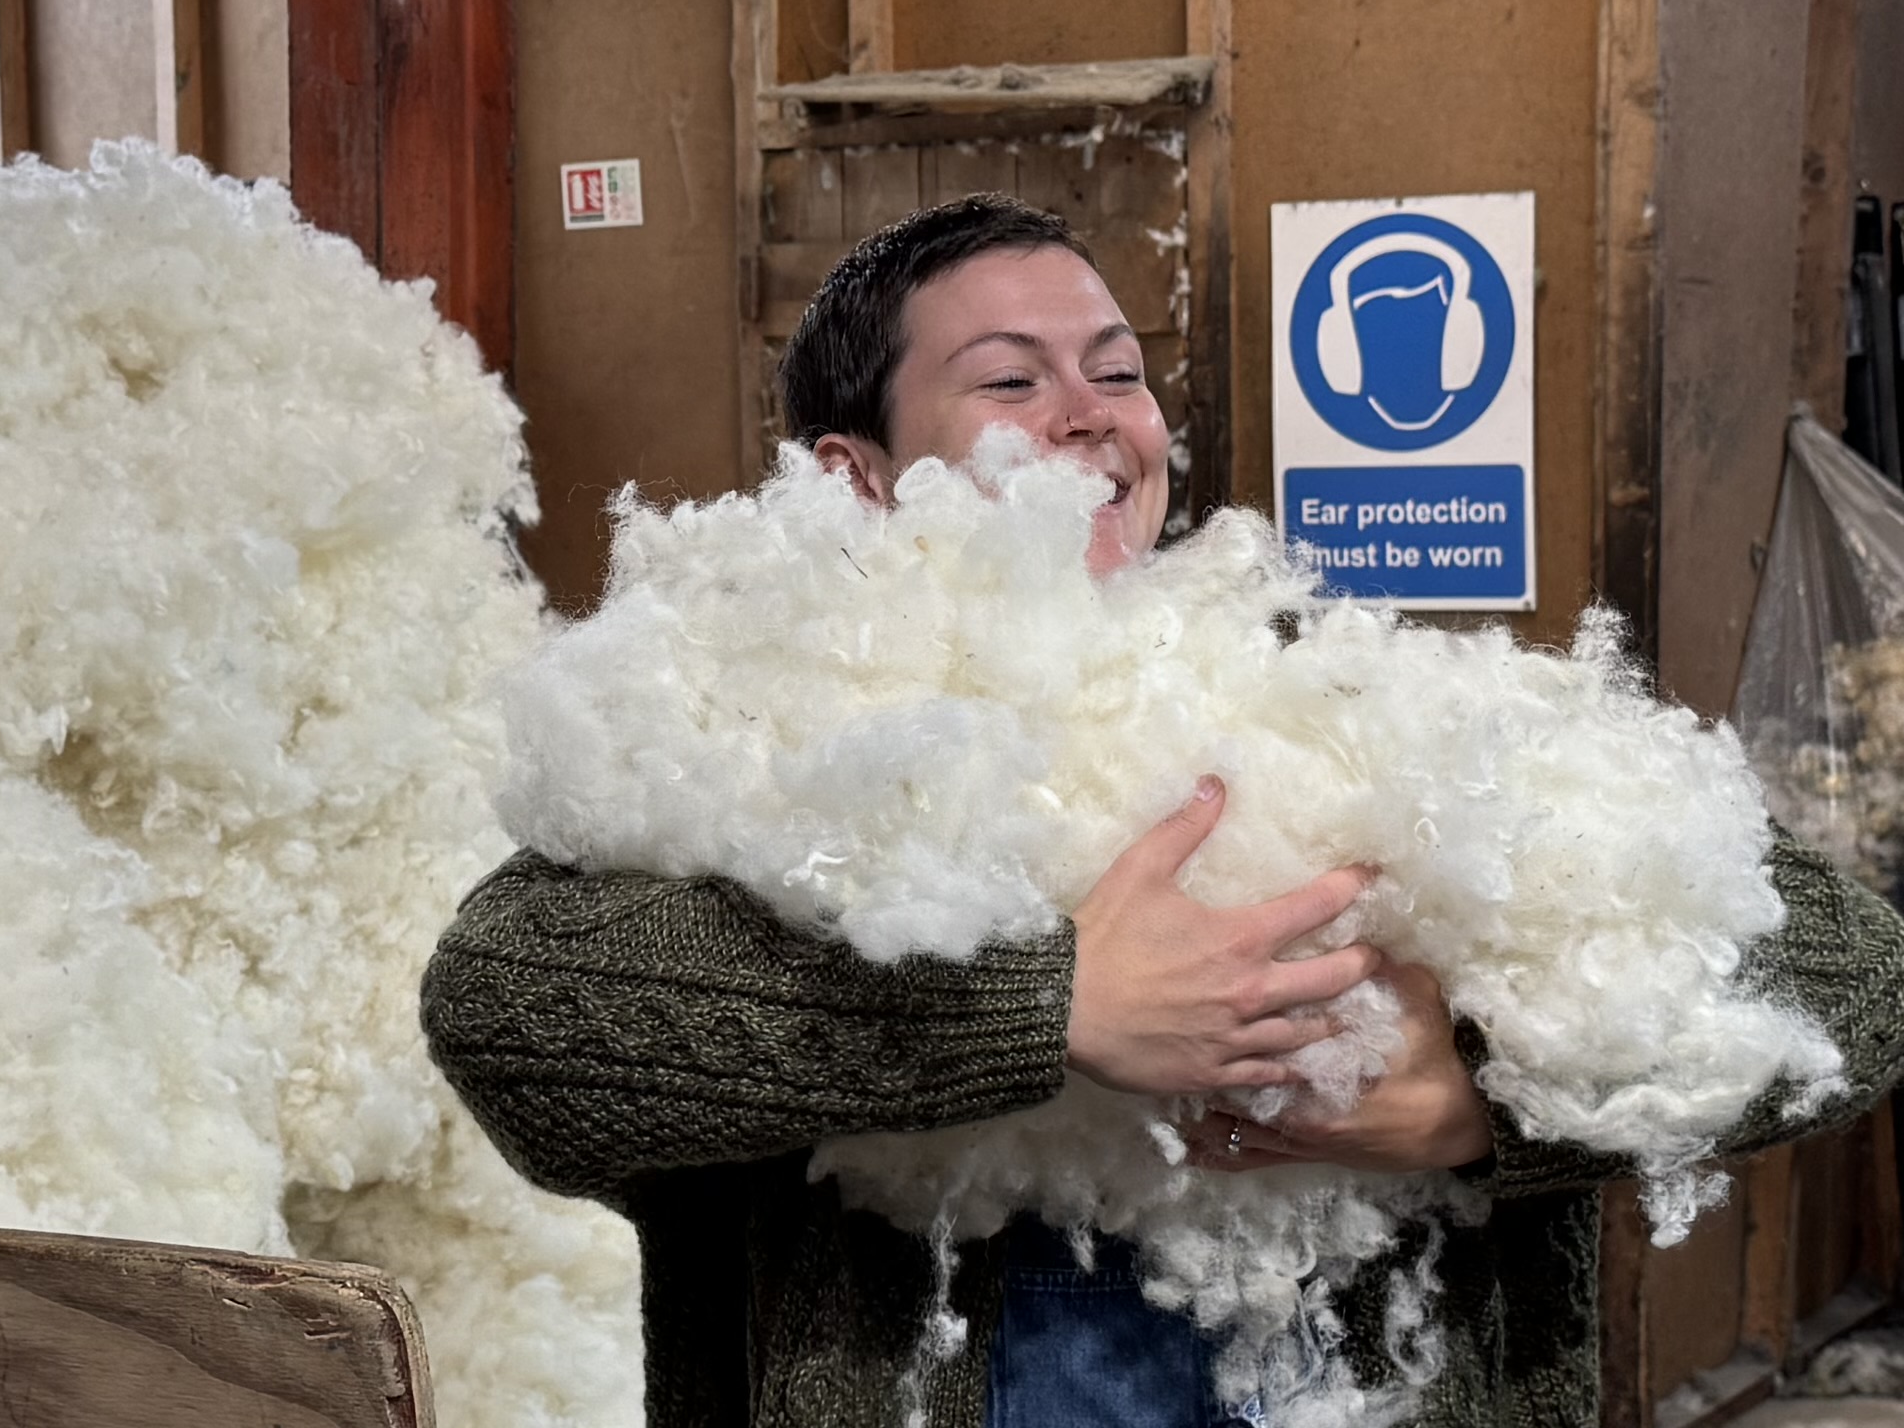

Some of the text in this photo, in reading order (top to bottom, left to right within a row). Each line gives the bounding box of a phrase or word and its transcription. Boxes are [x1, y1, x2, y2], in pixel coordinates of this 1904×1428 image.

[1301, 496, 1507, 531] Ear protection
[1385, 540, 1421, 568] be
[1428, 545, 1503, 568] worn
